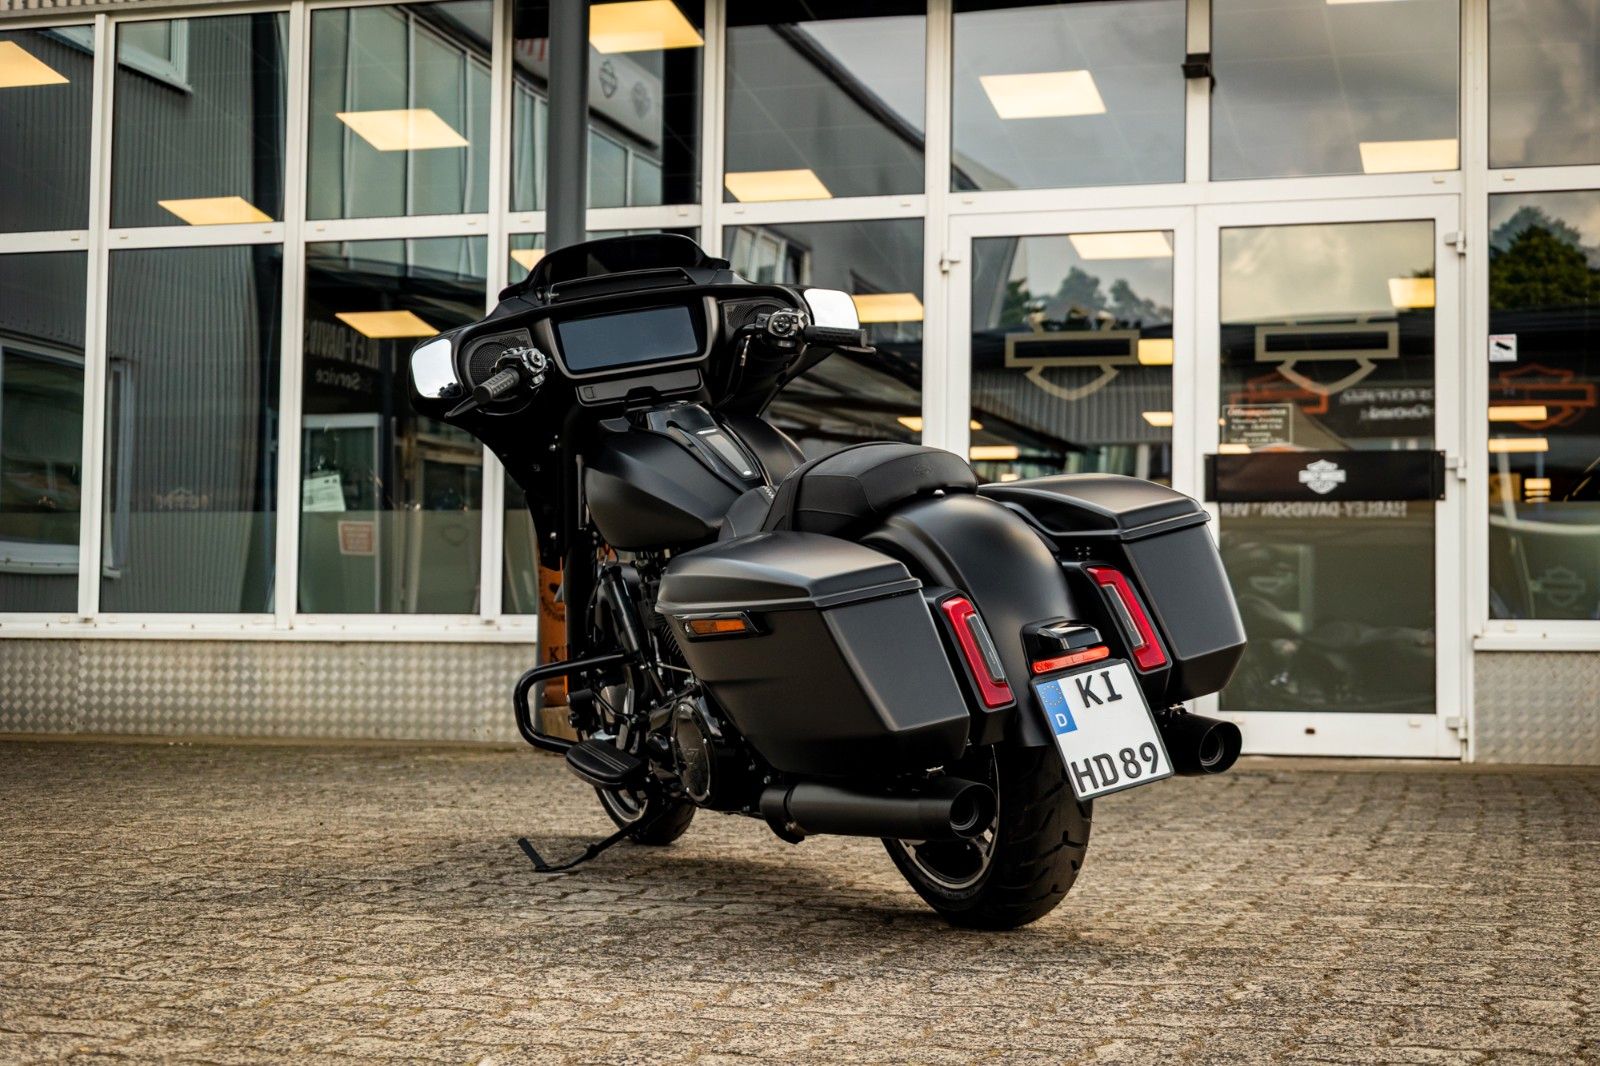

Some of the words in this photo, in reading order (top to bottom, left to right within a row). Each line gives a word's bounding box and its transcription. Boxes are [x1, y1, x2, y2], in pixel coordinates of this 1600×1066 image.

[1075, 670, 1122, 708] KI
[1055, 713, 1067, 727] D
[1071, 742, 1159, 793] HD89
